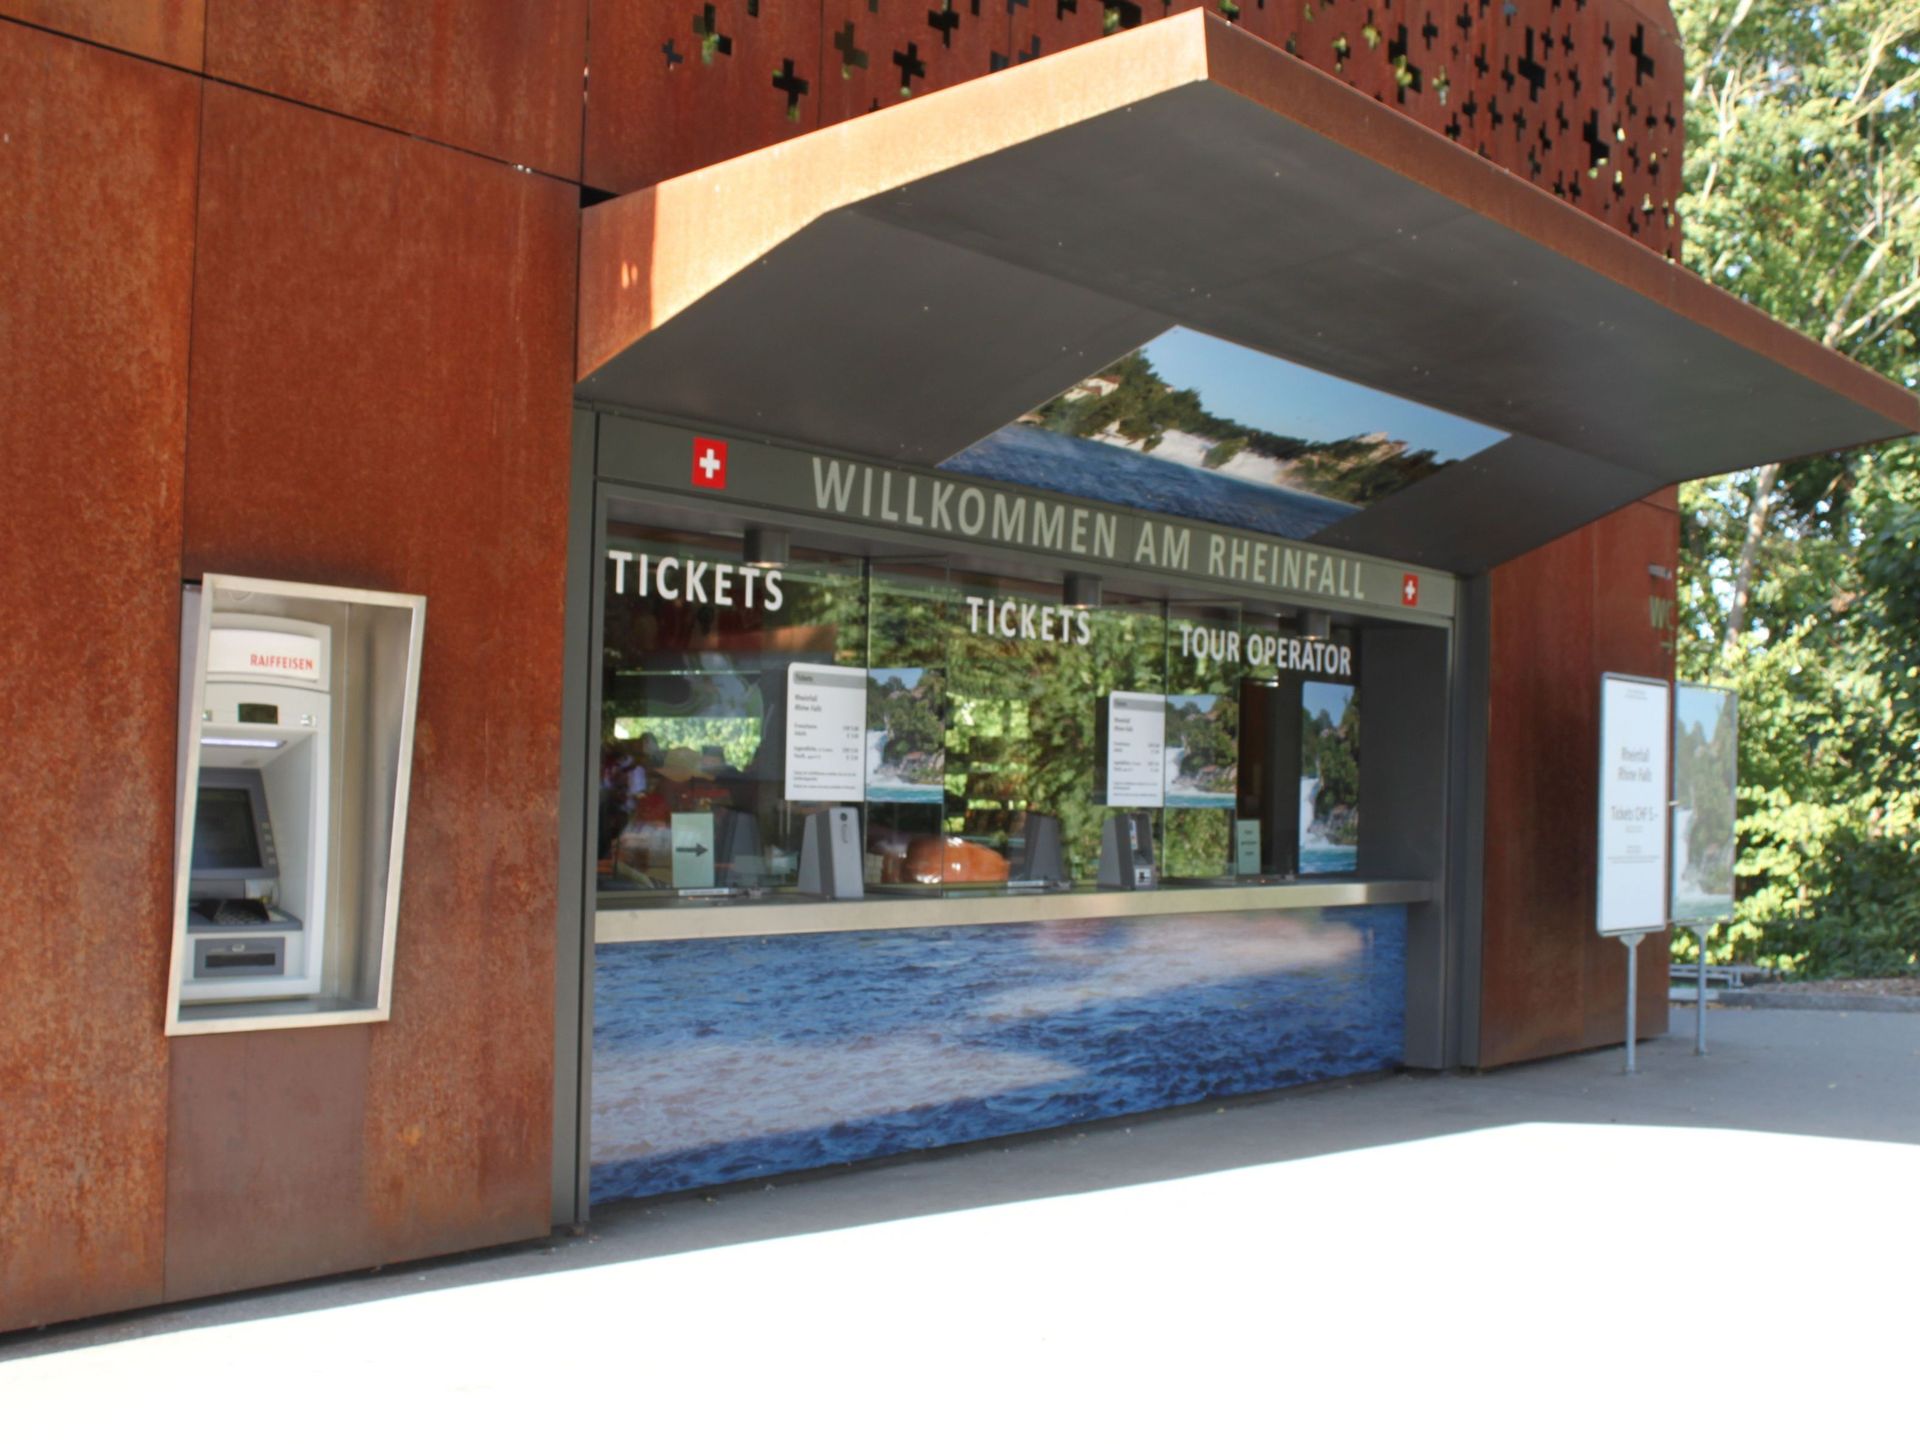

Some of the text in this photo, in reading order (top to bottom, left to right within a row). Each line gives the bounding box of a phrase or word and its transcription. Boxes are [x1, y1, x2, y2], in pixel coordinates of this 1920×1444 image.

[812, 456, 1366, 600] WILLKOMMEN AM RHEINFALL
[608, 550, 784, 612] TICKETS
[966, 596, 1091, 646] TICKETS
[250, 653, 314, 670] RAIFFEISEN
[1179, 624, 1352, 676] TOUR OPERATOR
